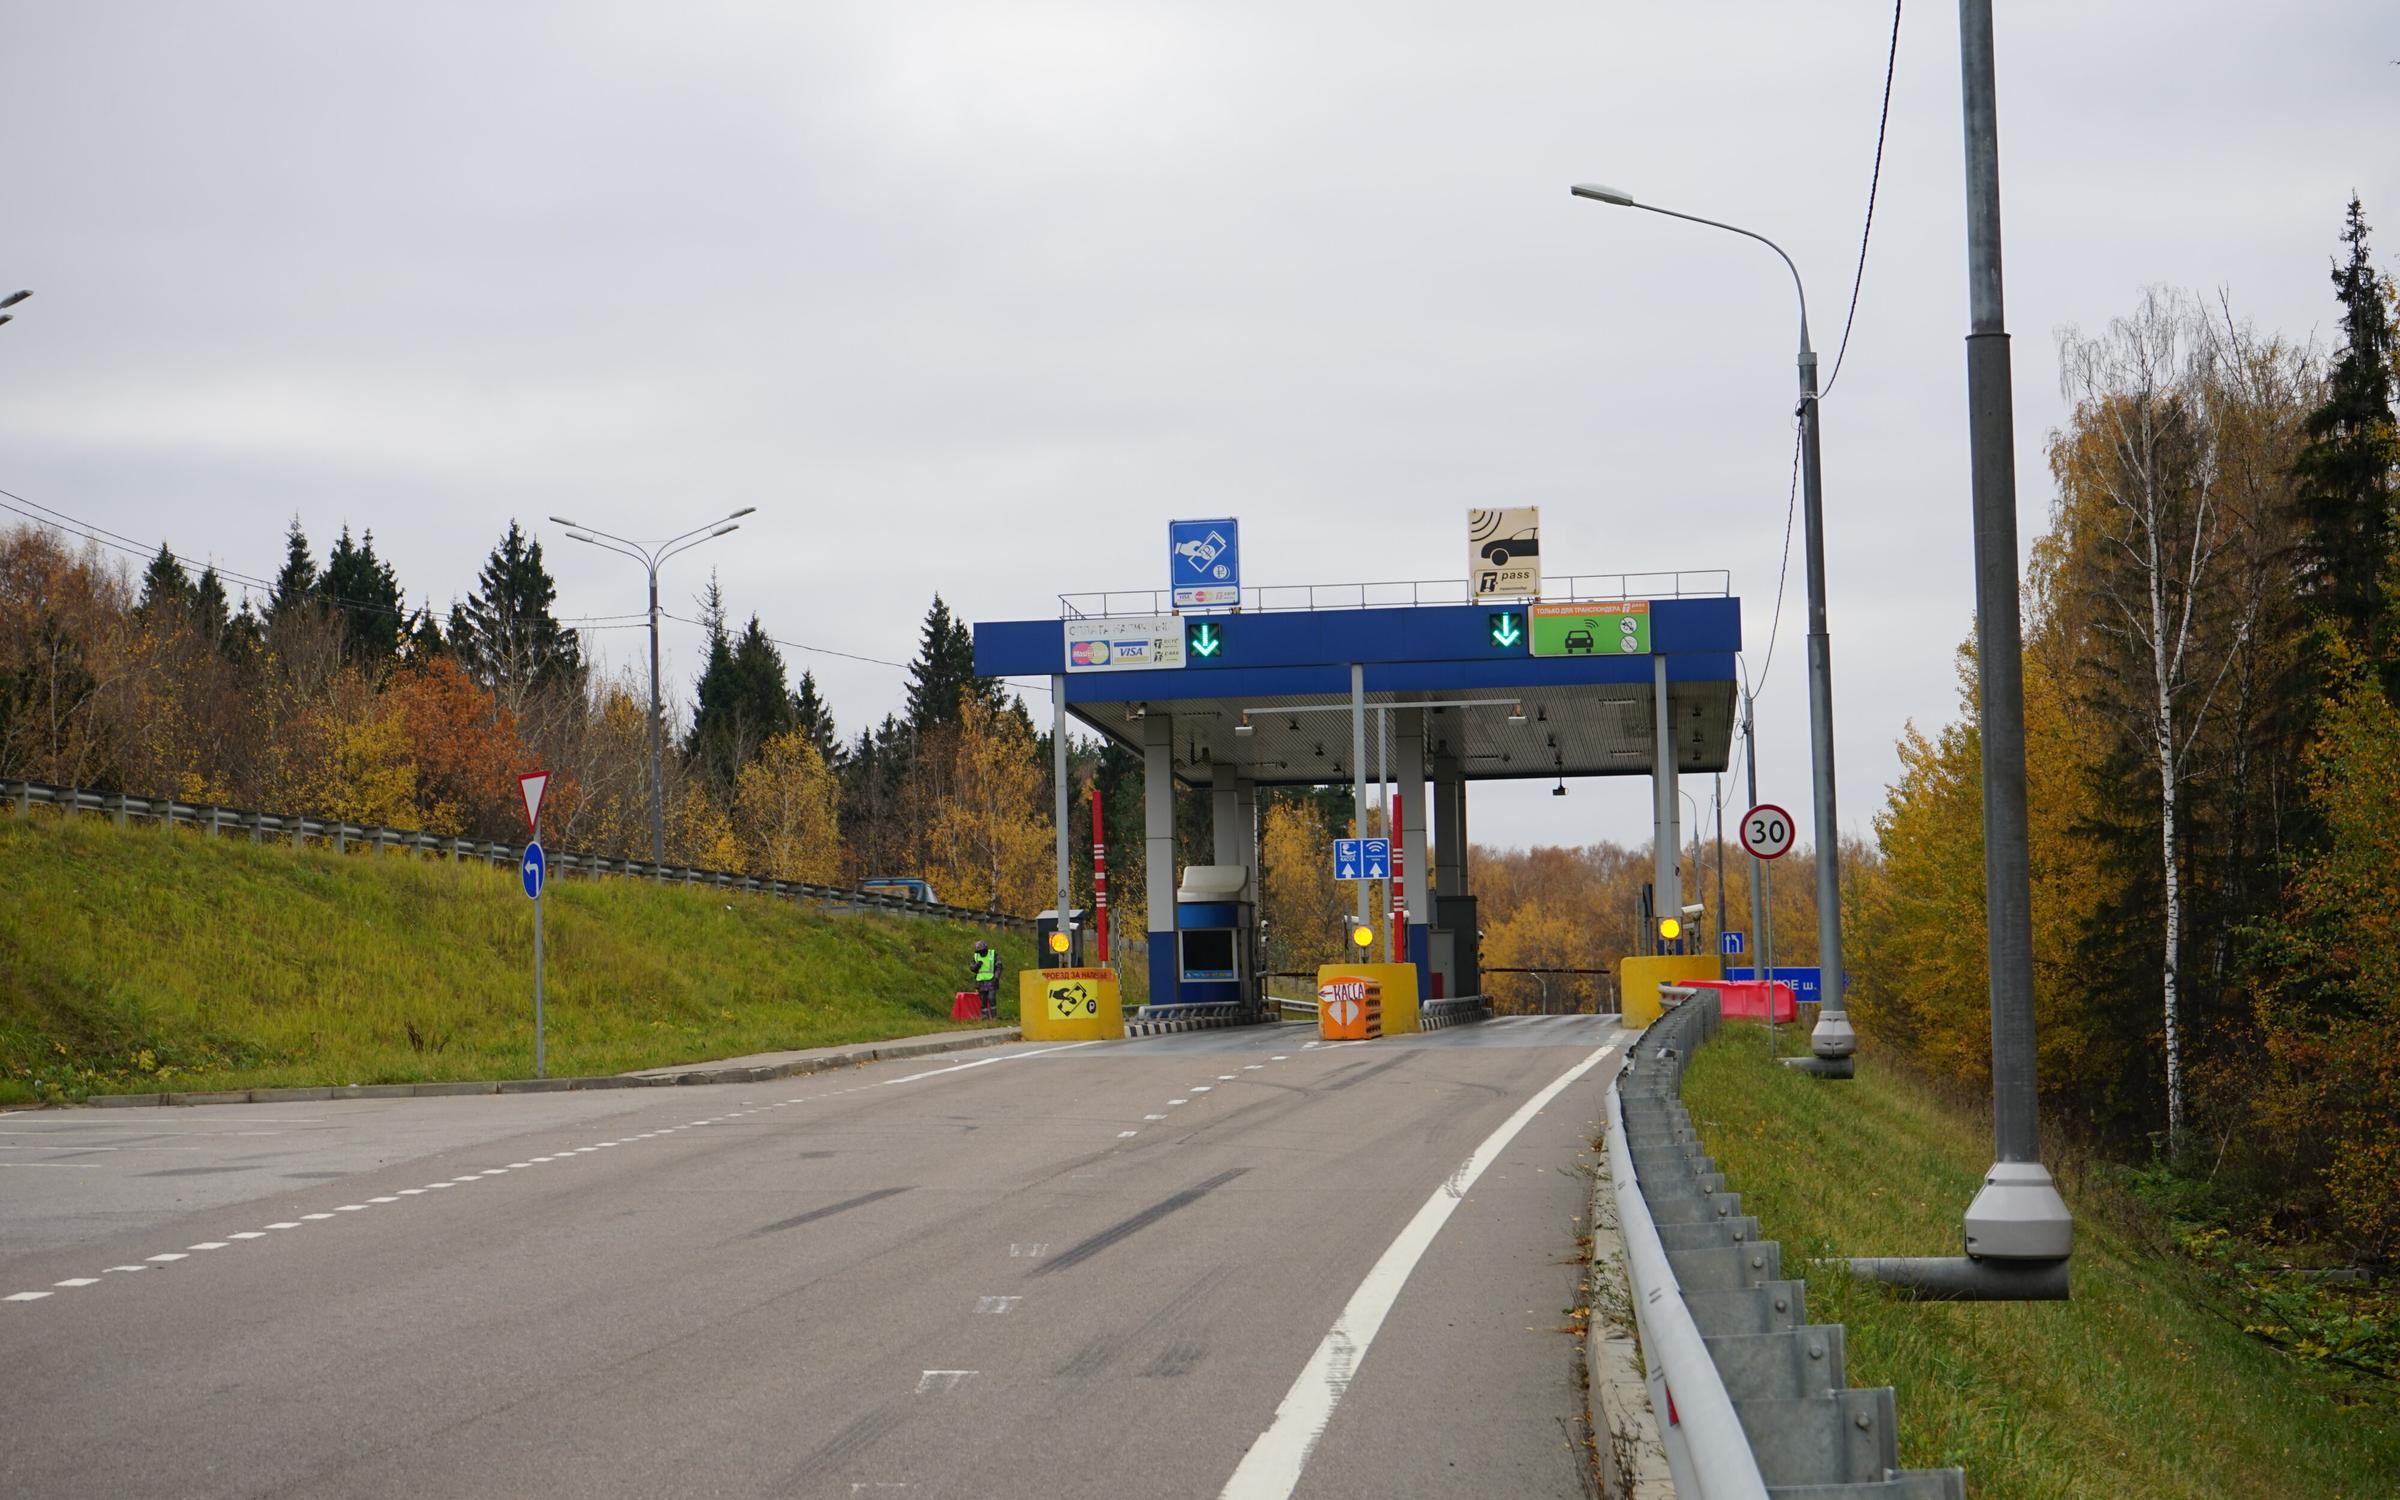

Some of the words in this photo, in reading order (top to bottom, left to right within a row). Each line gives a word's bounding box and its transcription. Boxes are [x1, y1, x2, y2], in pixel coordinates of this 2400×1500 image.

[1501, 571, 1530, 582] pass
[1536, 607, 1560, 615] ТОЛЬКО
[1119, 647, 1143, 656] VISA
[1752, 820, 1785, 844] 30
[1042, 971, 1070, 980] ПРОЕЗД
[1071, 971, 1081, 979] ЗА
[1803, 981, 1817, 991] ш.
[1333, 983, 1365, 1001] КАССА
